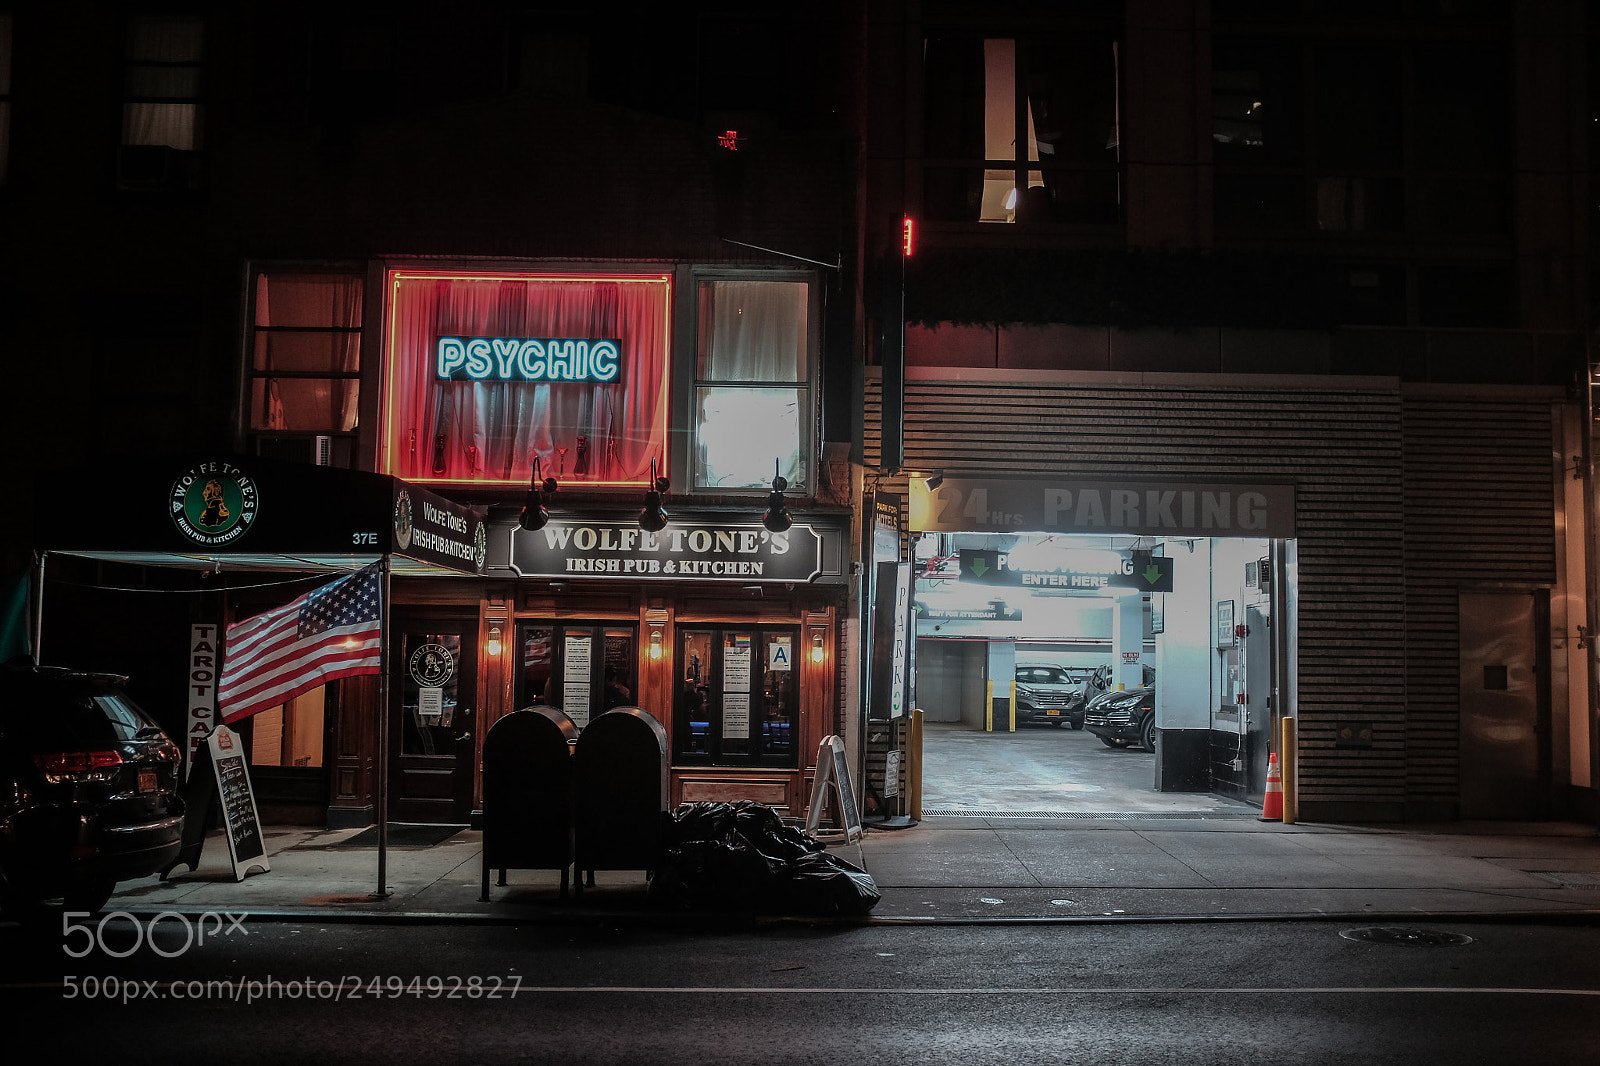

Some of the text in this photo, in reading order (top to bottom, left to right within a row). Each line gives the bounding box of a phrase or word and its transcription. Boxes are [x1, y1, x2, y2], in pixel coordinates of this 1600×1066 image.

[437, 338, 618, 381] PSYCHIC
[222, 462, 255, 508] TONE'S
[423, 501, 467, 534] WOLFE TONE'S
[937, 488, 988, 524] 24
[1044, 488, 1268, 530] PARKING
[177, 517, 194, 536] IRISH
[191, 530, 206, 542] PUB
[213, 525, 242, 544] KITCHEN
[352, 532, 378, 545] 37E
[412, 527, 431, 550] IRISH
[431, 534, 445, 552] PUB
[449, 538, 474, 561] KITCHEN
[544, 527, 790, 555] WOLFE TONE'S
[565, 558, 764, 575] IRISH PUB & KITCHEN
[1021, 574, 1109, 588] ENTER HERE
[191, 626, 214, 697] TAROT
[773, 646, 788, 663] A
